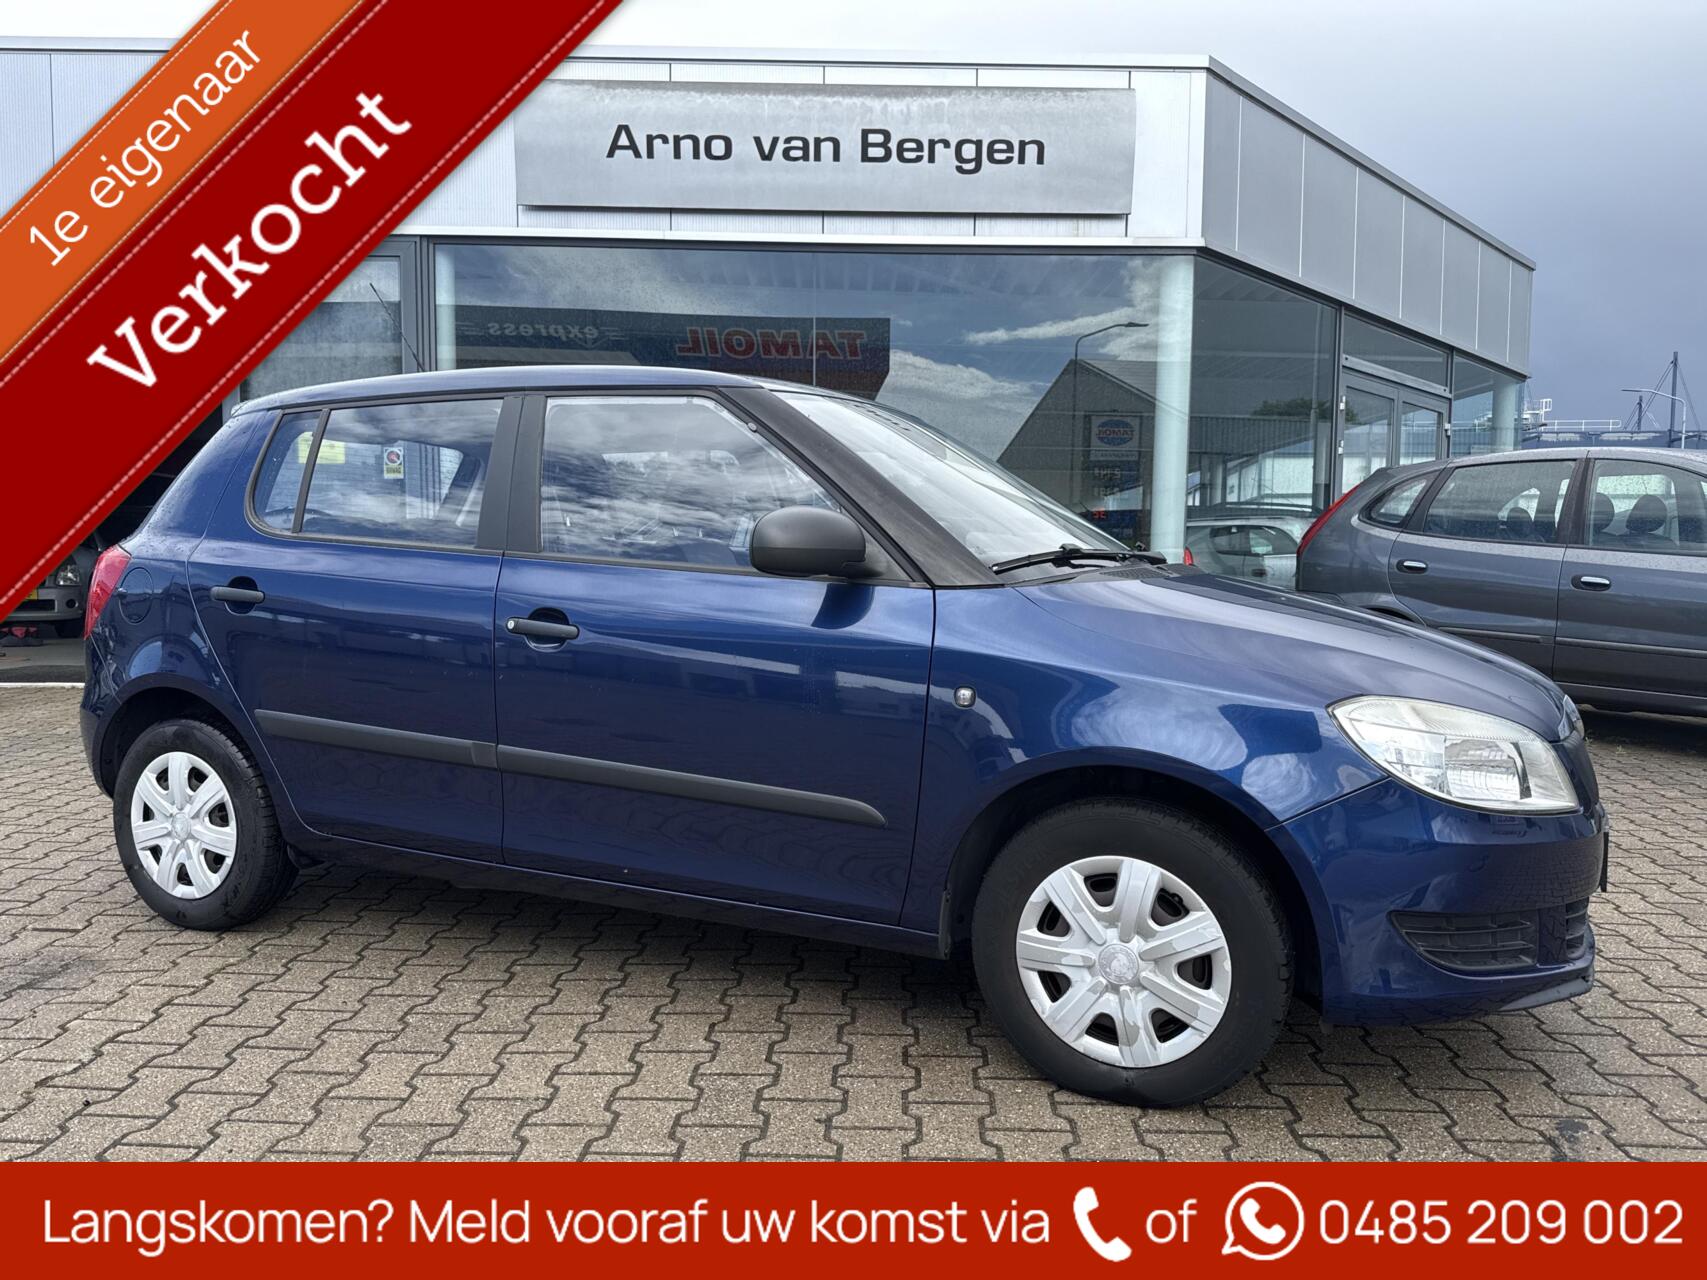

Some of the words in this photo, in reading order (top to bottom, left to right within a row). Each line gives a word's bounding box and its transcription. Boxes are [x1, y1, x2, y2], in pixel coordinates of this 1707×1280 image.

[606, 124, 732, 161] Arno
[754, 136, 841, 162] van
[860, 128, 1045, 175] Bergen
